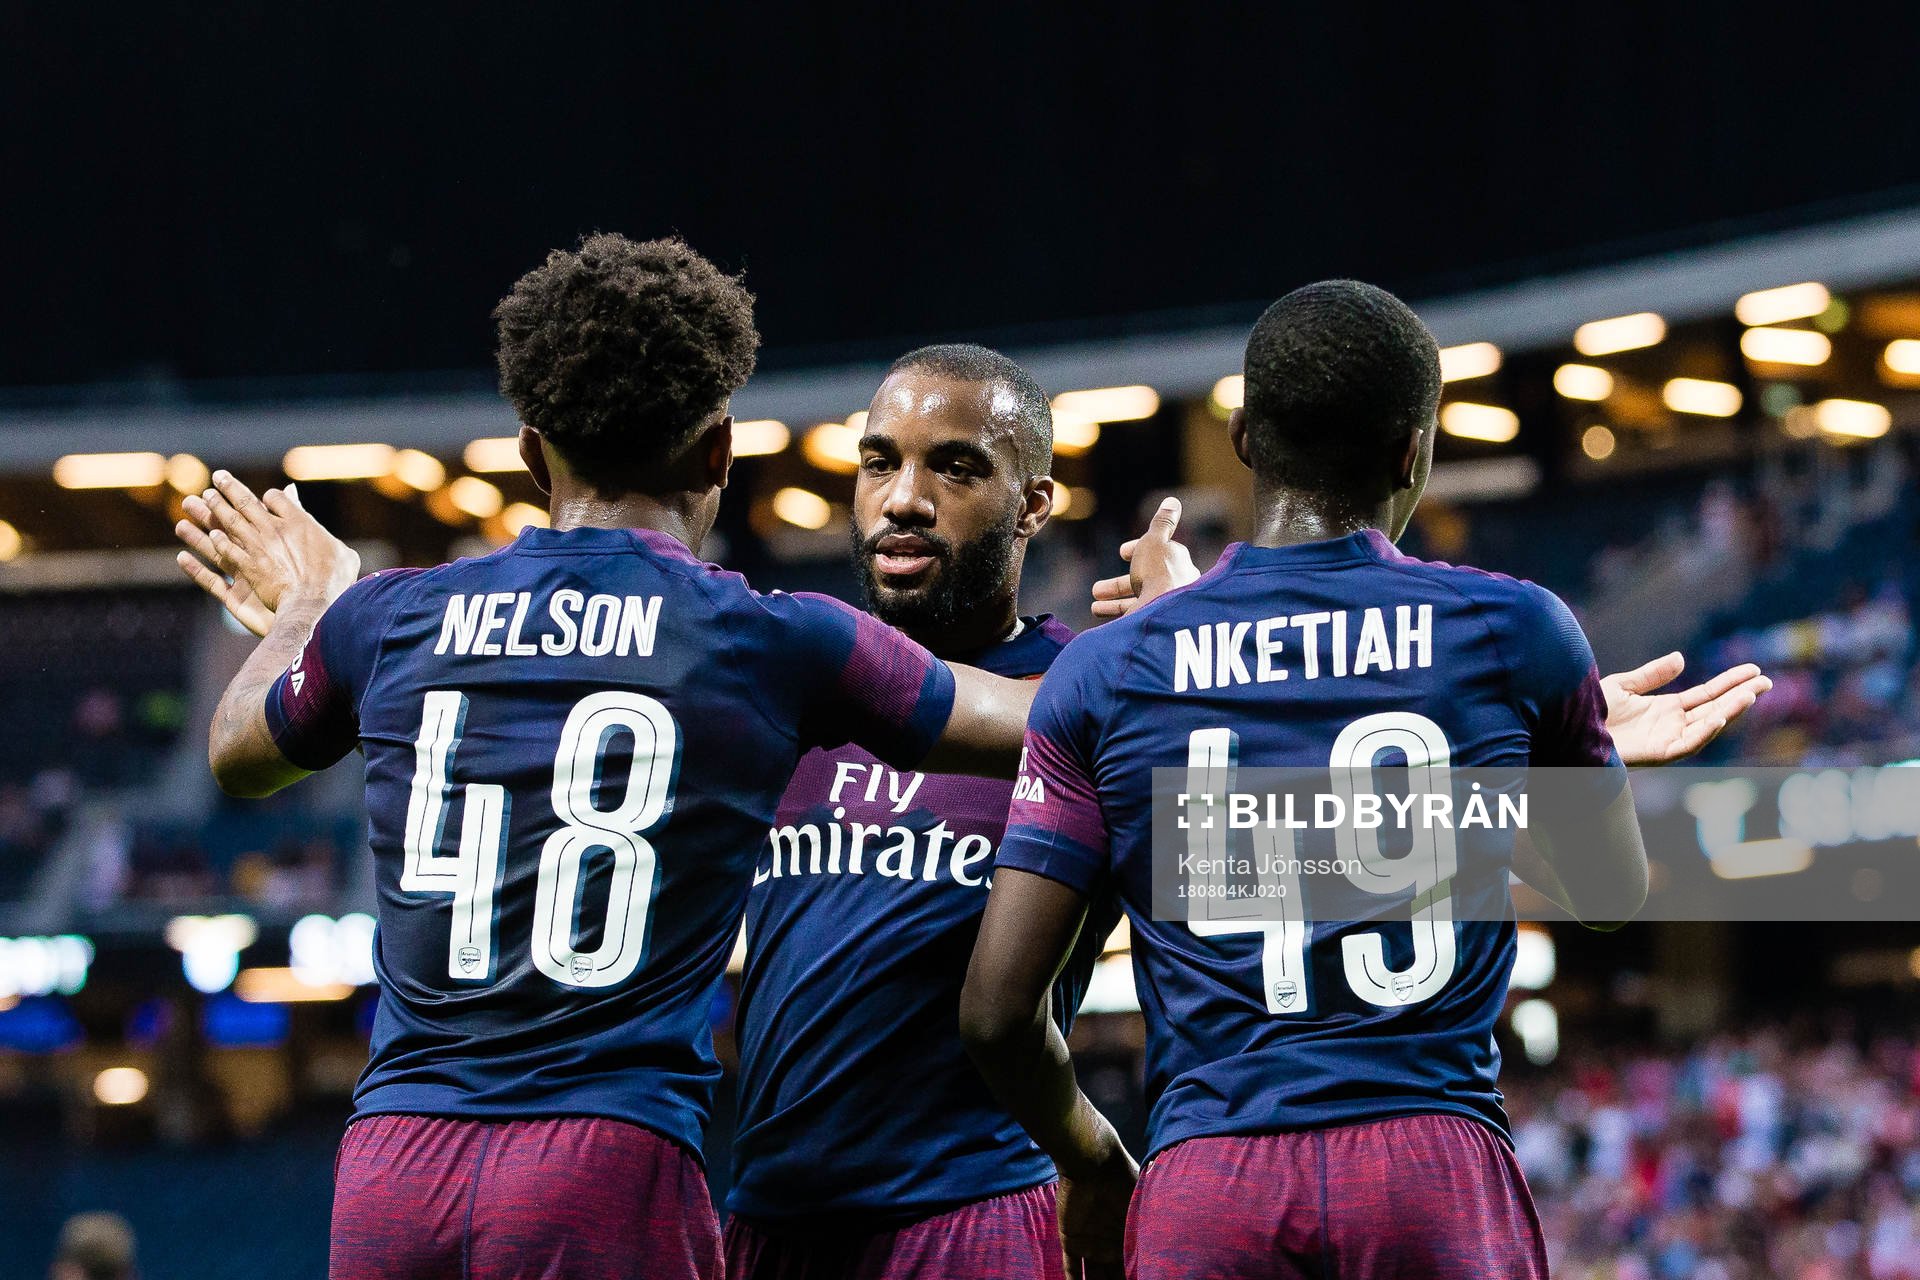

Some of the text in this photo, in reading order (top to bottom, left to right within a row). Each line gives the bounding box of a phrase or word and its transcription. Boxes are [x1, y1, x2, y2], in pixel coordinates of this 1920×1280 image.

[434, 589, 663, 657] NELSON
[1174, 604, 1433, 693] NKETIAH
[829, 761, 925, 813] Fly
[400, 690, 680, 988] 48
[752, 806, 1001, 890] mirate
[1186, 711, 1458, 1015] 49
